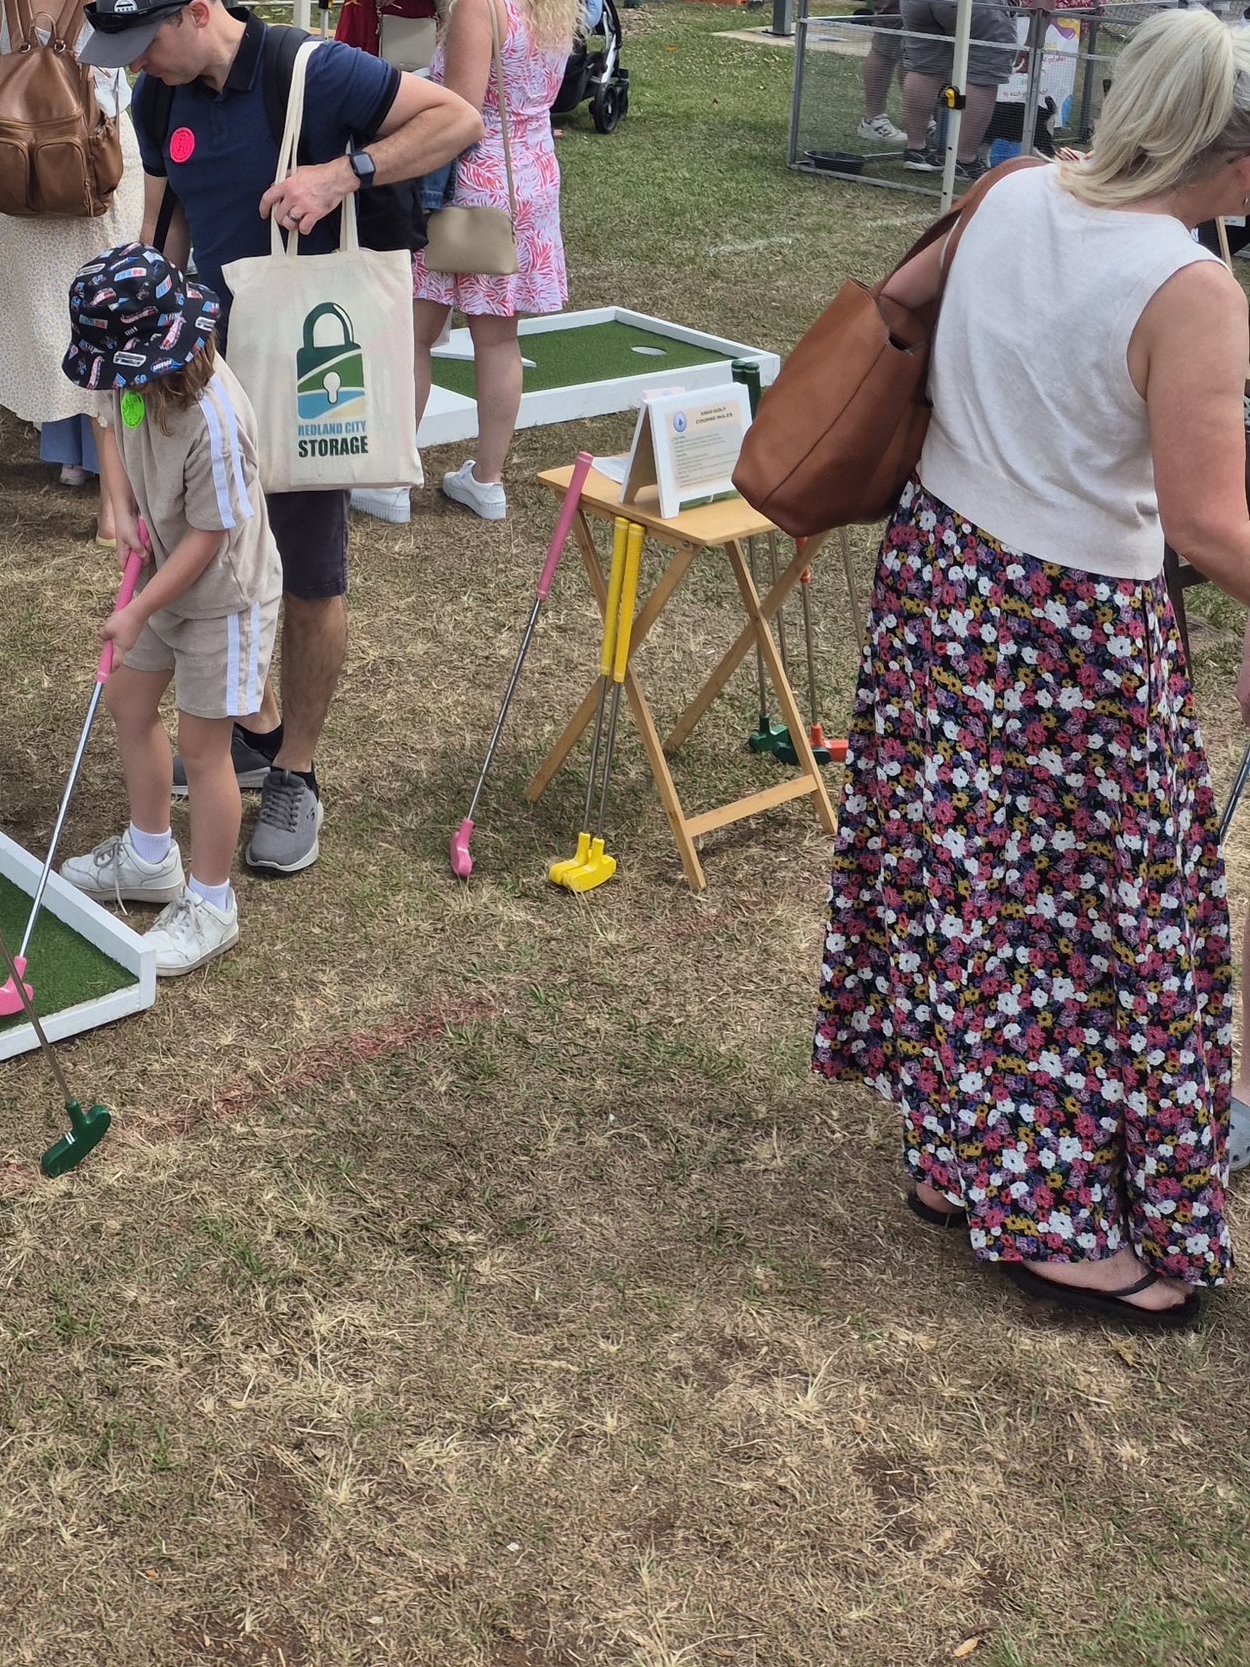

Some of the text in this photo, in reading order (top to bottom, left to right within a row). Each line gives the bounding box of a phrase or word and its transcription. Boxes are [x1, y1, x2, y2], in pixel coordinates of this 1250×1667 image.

[297, 420, 366, 436] REDLAND CITY
[298, 435, 369, 458] STORAGE
